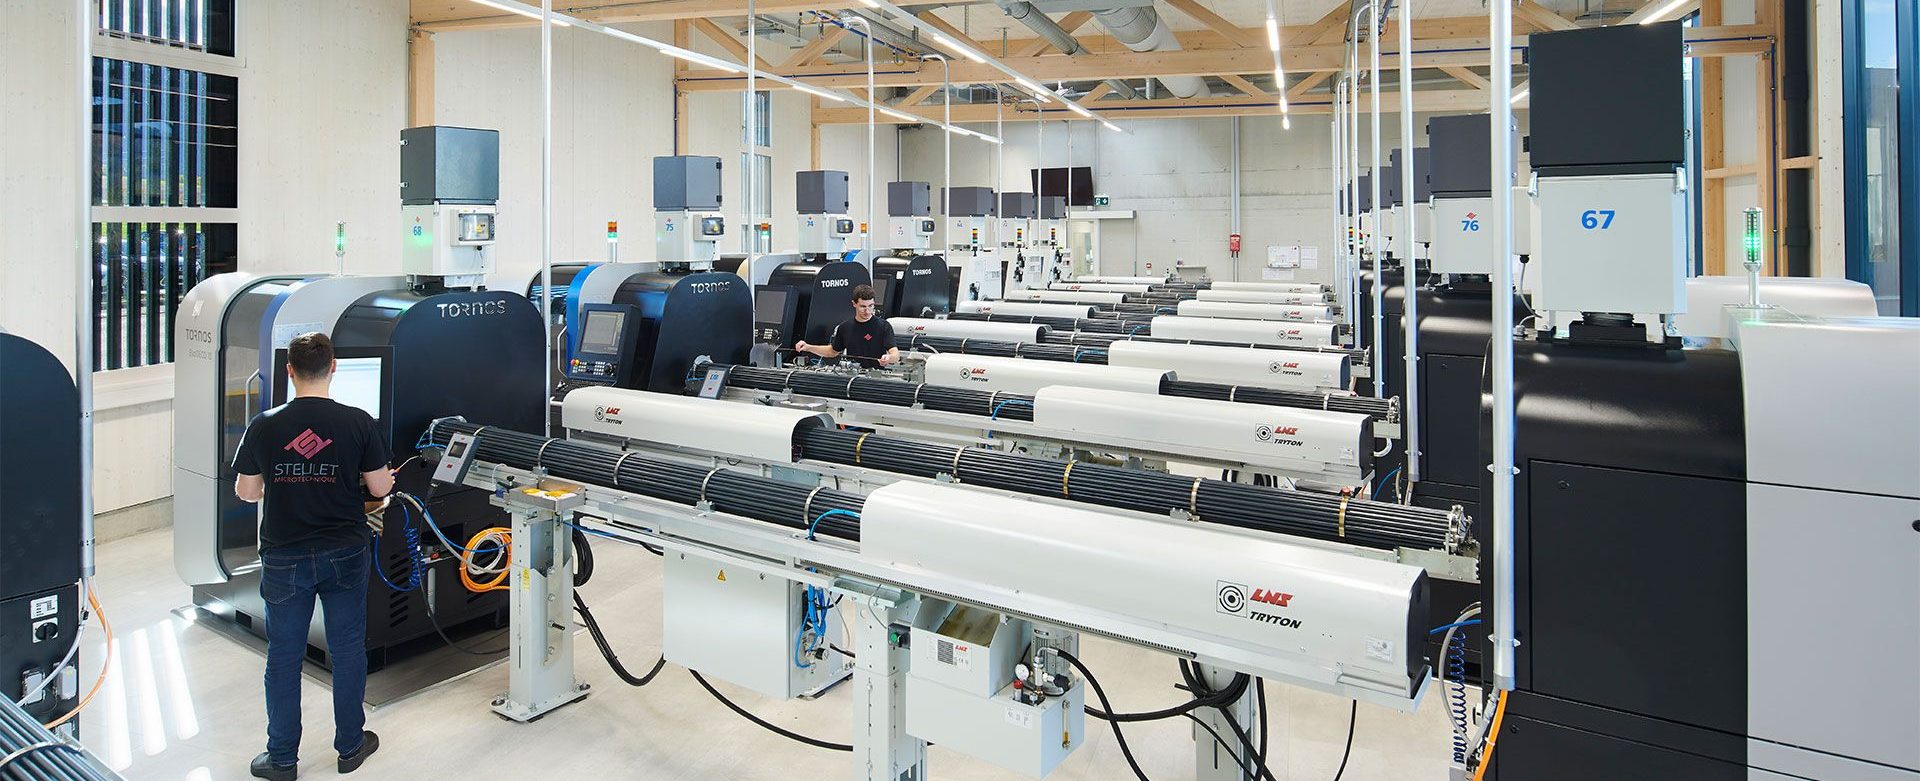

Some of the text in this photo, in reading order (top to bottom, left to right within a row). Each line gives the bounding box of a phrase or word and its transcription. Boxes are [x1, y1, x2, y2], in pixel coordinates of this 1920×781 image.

[1461, 220, 1480, 232] 76
[1581, 210, 1616, 230] 67
[413, 225, 422, 236] 68
[665, 223, 674, 232] 75
[912, 268, 932, 276] TORNOS
[690, 281, 730, 294] TORNOS
[820, 278, 849, 288] TORNOS
[436, 299, 506, 318] TORNOS
[185, 328, 212, 344] TORNOS
[1274, 426, 1299, 436] LNS
[1273, 438, 1304, 447] TRYTON
[1249, 588, 1294, 608] LNS
[1249, 611, 1303, 630] TRYTON
